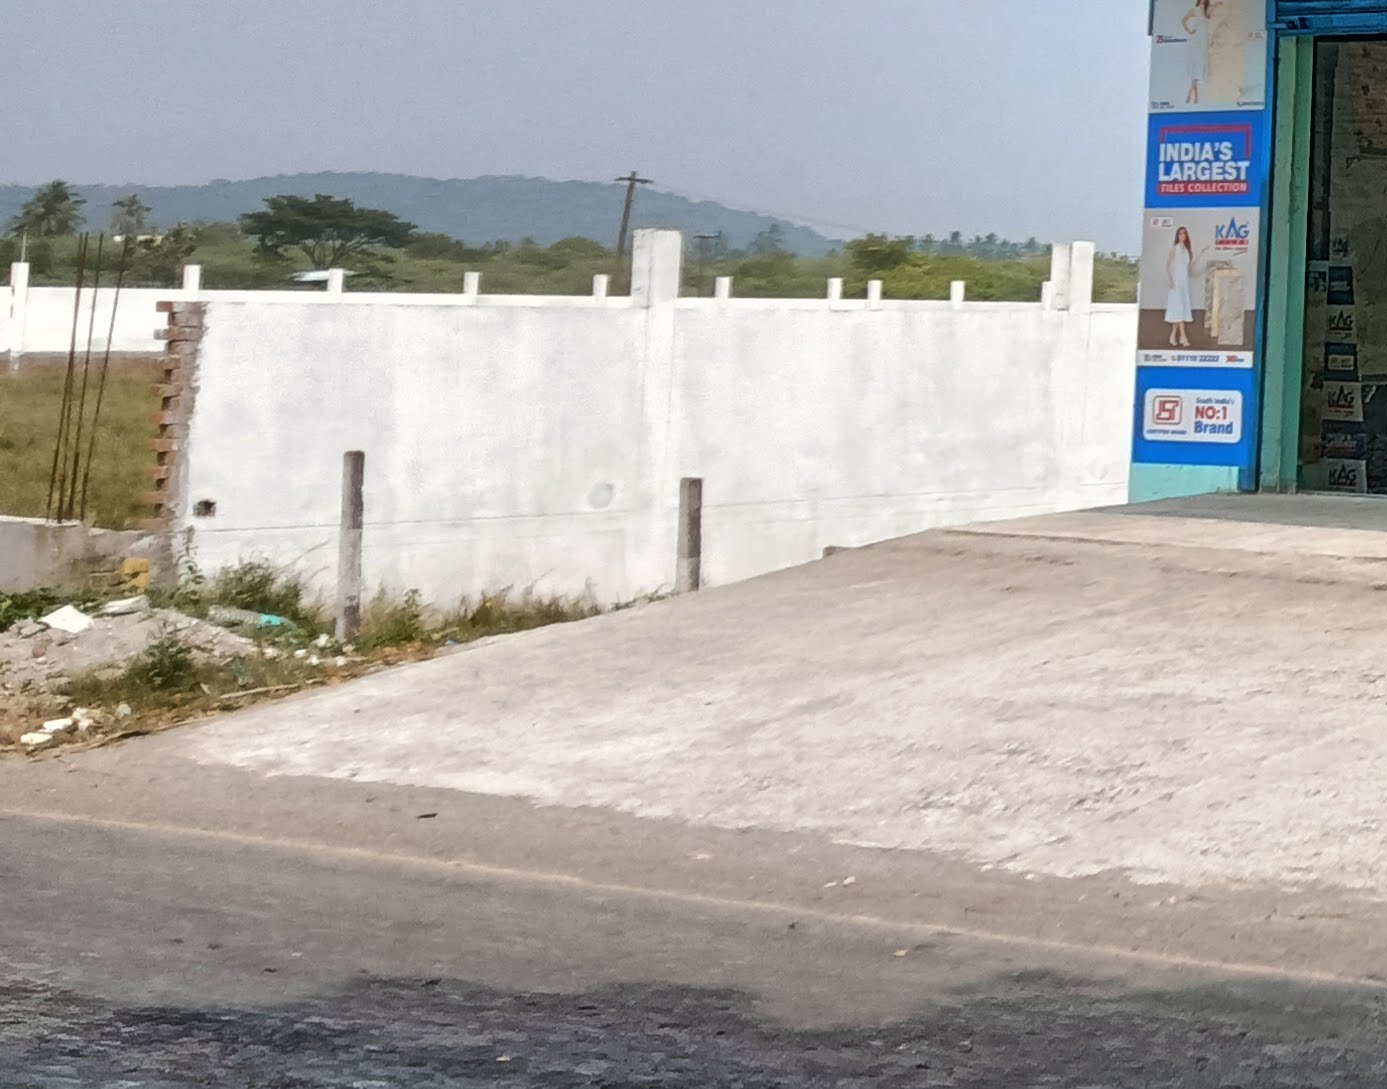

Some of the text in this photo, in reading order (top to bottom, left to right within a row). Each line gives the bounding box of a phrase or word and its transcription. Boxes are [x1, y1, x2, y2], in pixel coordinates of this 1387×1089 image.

[1159, 141, 1233, 161] INDIA'S
[1158, 161, 1250, 181] LARGEST
[1160, 183, 1248, 193] TILES COLLECTION
[1215, 217, 1250, 239] KAG
[1194, 421, 1234, 434] Brand
